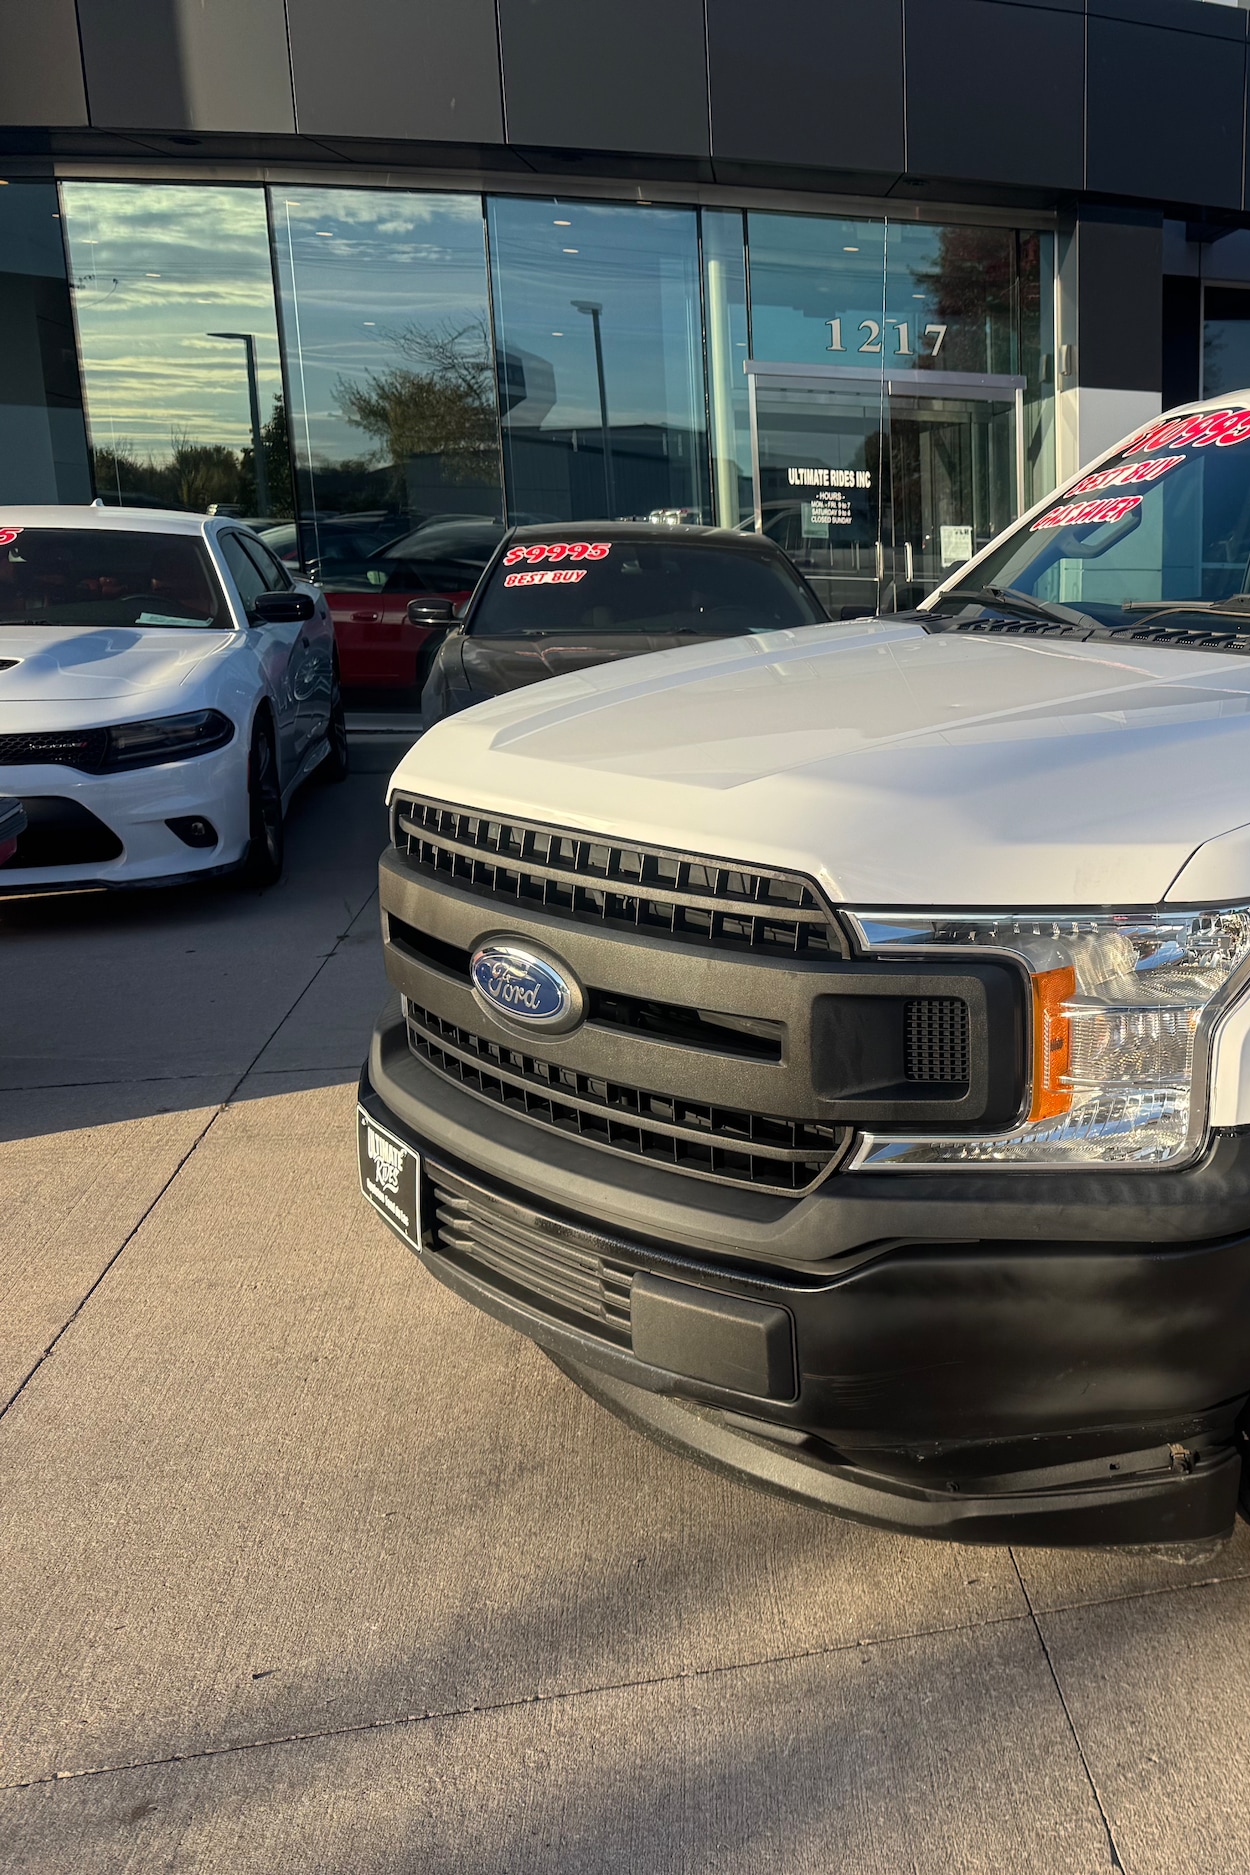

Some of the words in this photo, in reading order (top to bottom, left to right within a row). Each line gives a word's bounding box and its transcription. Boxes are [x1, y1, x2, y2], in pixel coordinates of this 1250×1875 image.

[825, 317, 948, 357] 1217
[788, 468, 829, 486] ULTIMATE
[830, 470, 855, 487] RIDES
[856, 471, 871, 488] INC
[1063, 463, 1138, 499] BEST
[1116, 455, 1186, 485] BUY
[812, 508, 837, 516] SATURDAY
[503, 542, 612, 566] $9995
[504, 571, 549, 587] BEST
[551, 569, 587, 584] BUY
[488, 962, 541, 1009] Ford
[367, 1126, 404, 1172] ULTIMATE
[374, 1156, 400, 1187] RIDES
